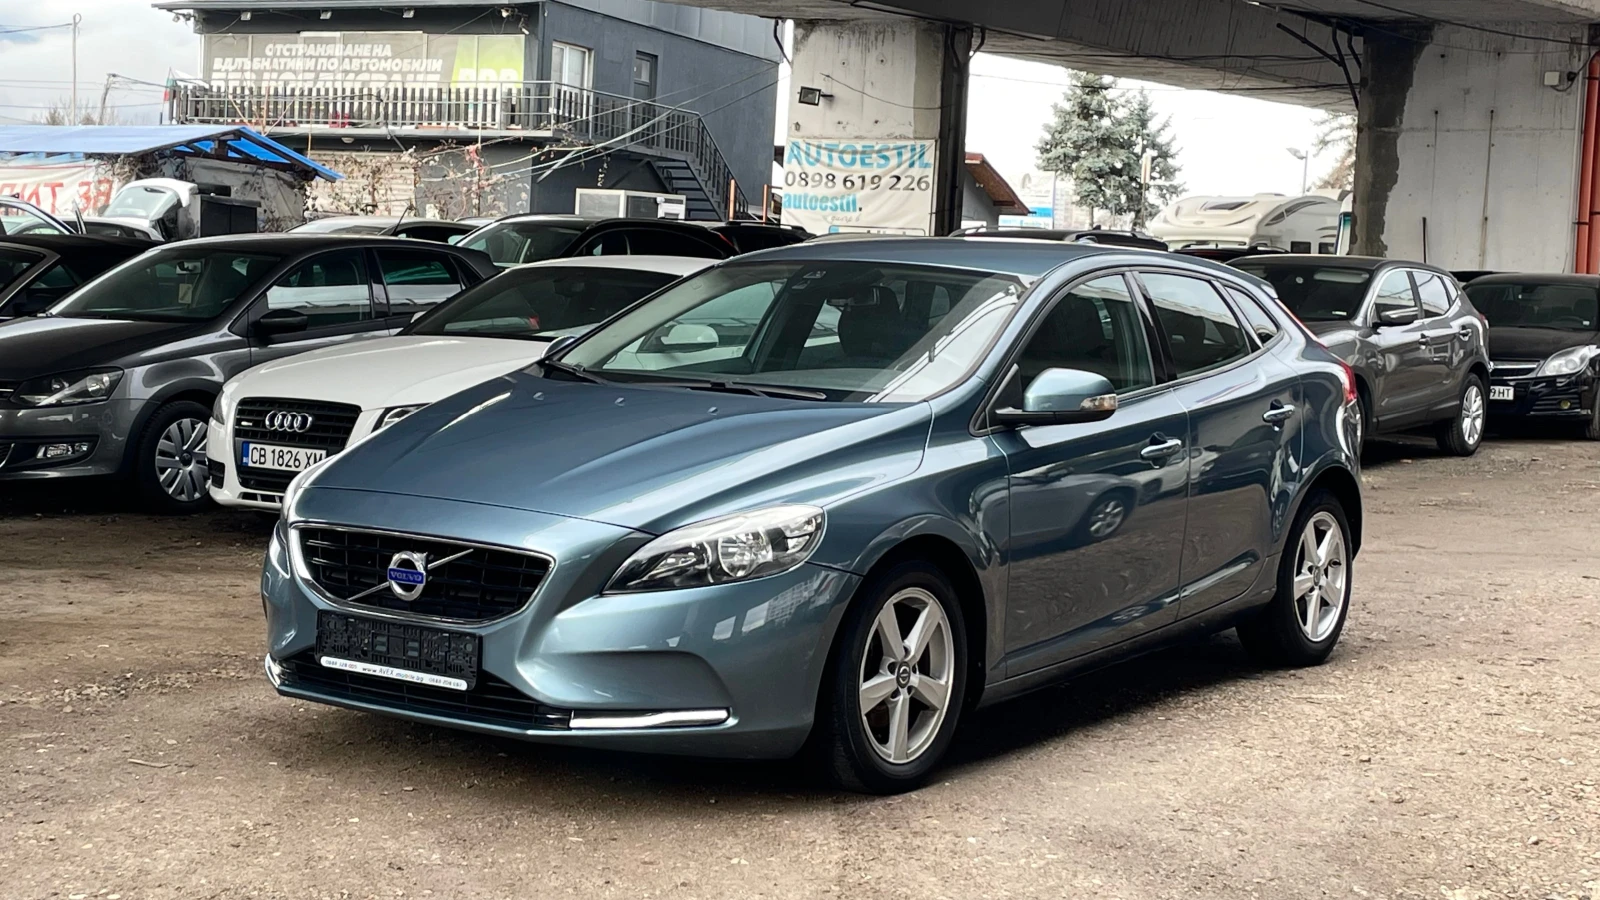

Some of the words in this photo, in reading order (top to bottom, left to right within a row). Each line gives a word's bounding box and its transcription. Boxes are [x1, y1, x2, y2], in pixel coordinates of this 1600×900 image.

[265, 43, 371, 57] ОТСТРАНЯВАНЕ
[372, 44, 392, 57] НА
[213, 57, 316, 71] ВДЛЪБНАТИНИ
[317, 57, 338, 71] ПО
[339, 58, 443, 72] АВТОМОБИЛИ
[786, 141, 932, 169] AUTOESTIL
[785, 171, 836, 189] 0898
[842, 174, 882, 191] 619
[888, 175, 930, 192] 226
[1498, 387, 1511, 398] HT
[251, 447, 267, 465] CB
[271, 448, 301, 469] 1826
[390, 571, 422, 582] VOLVO
